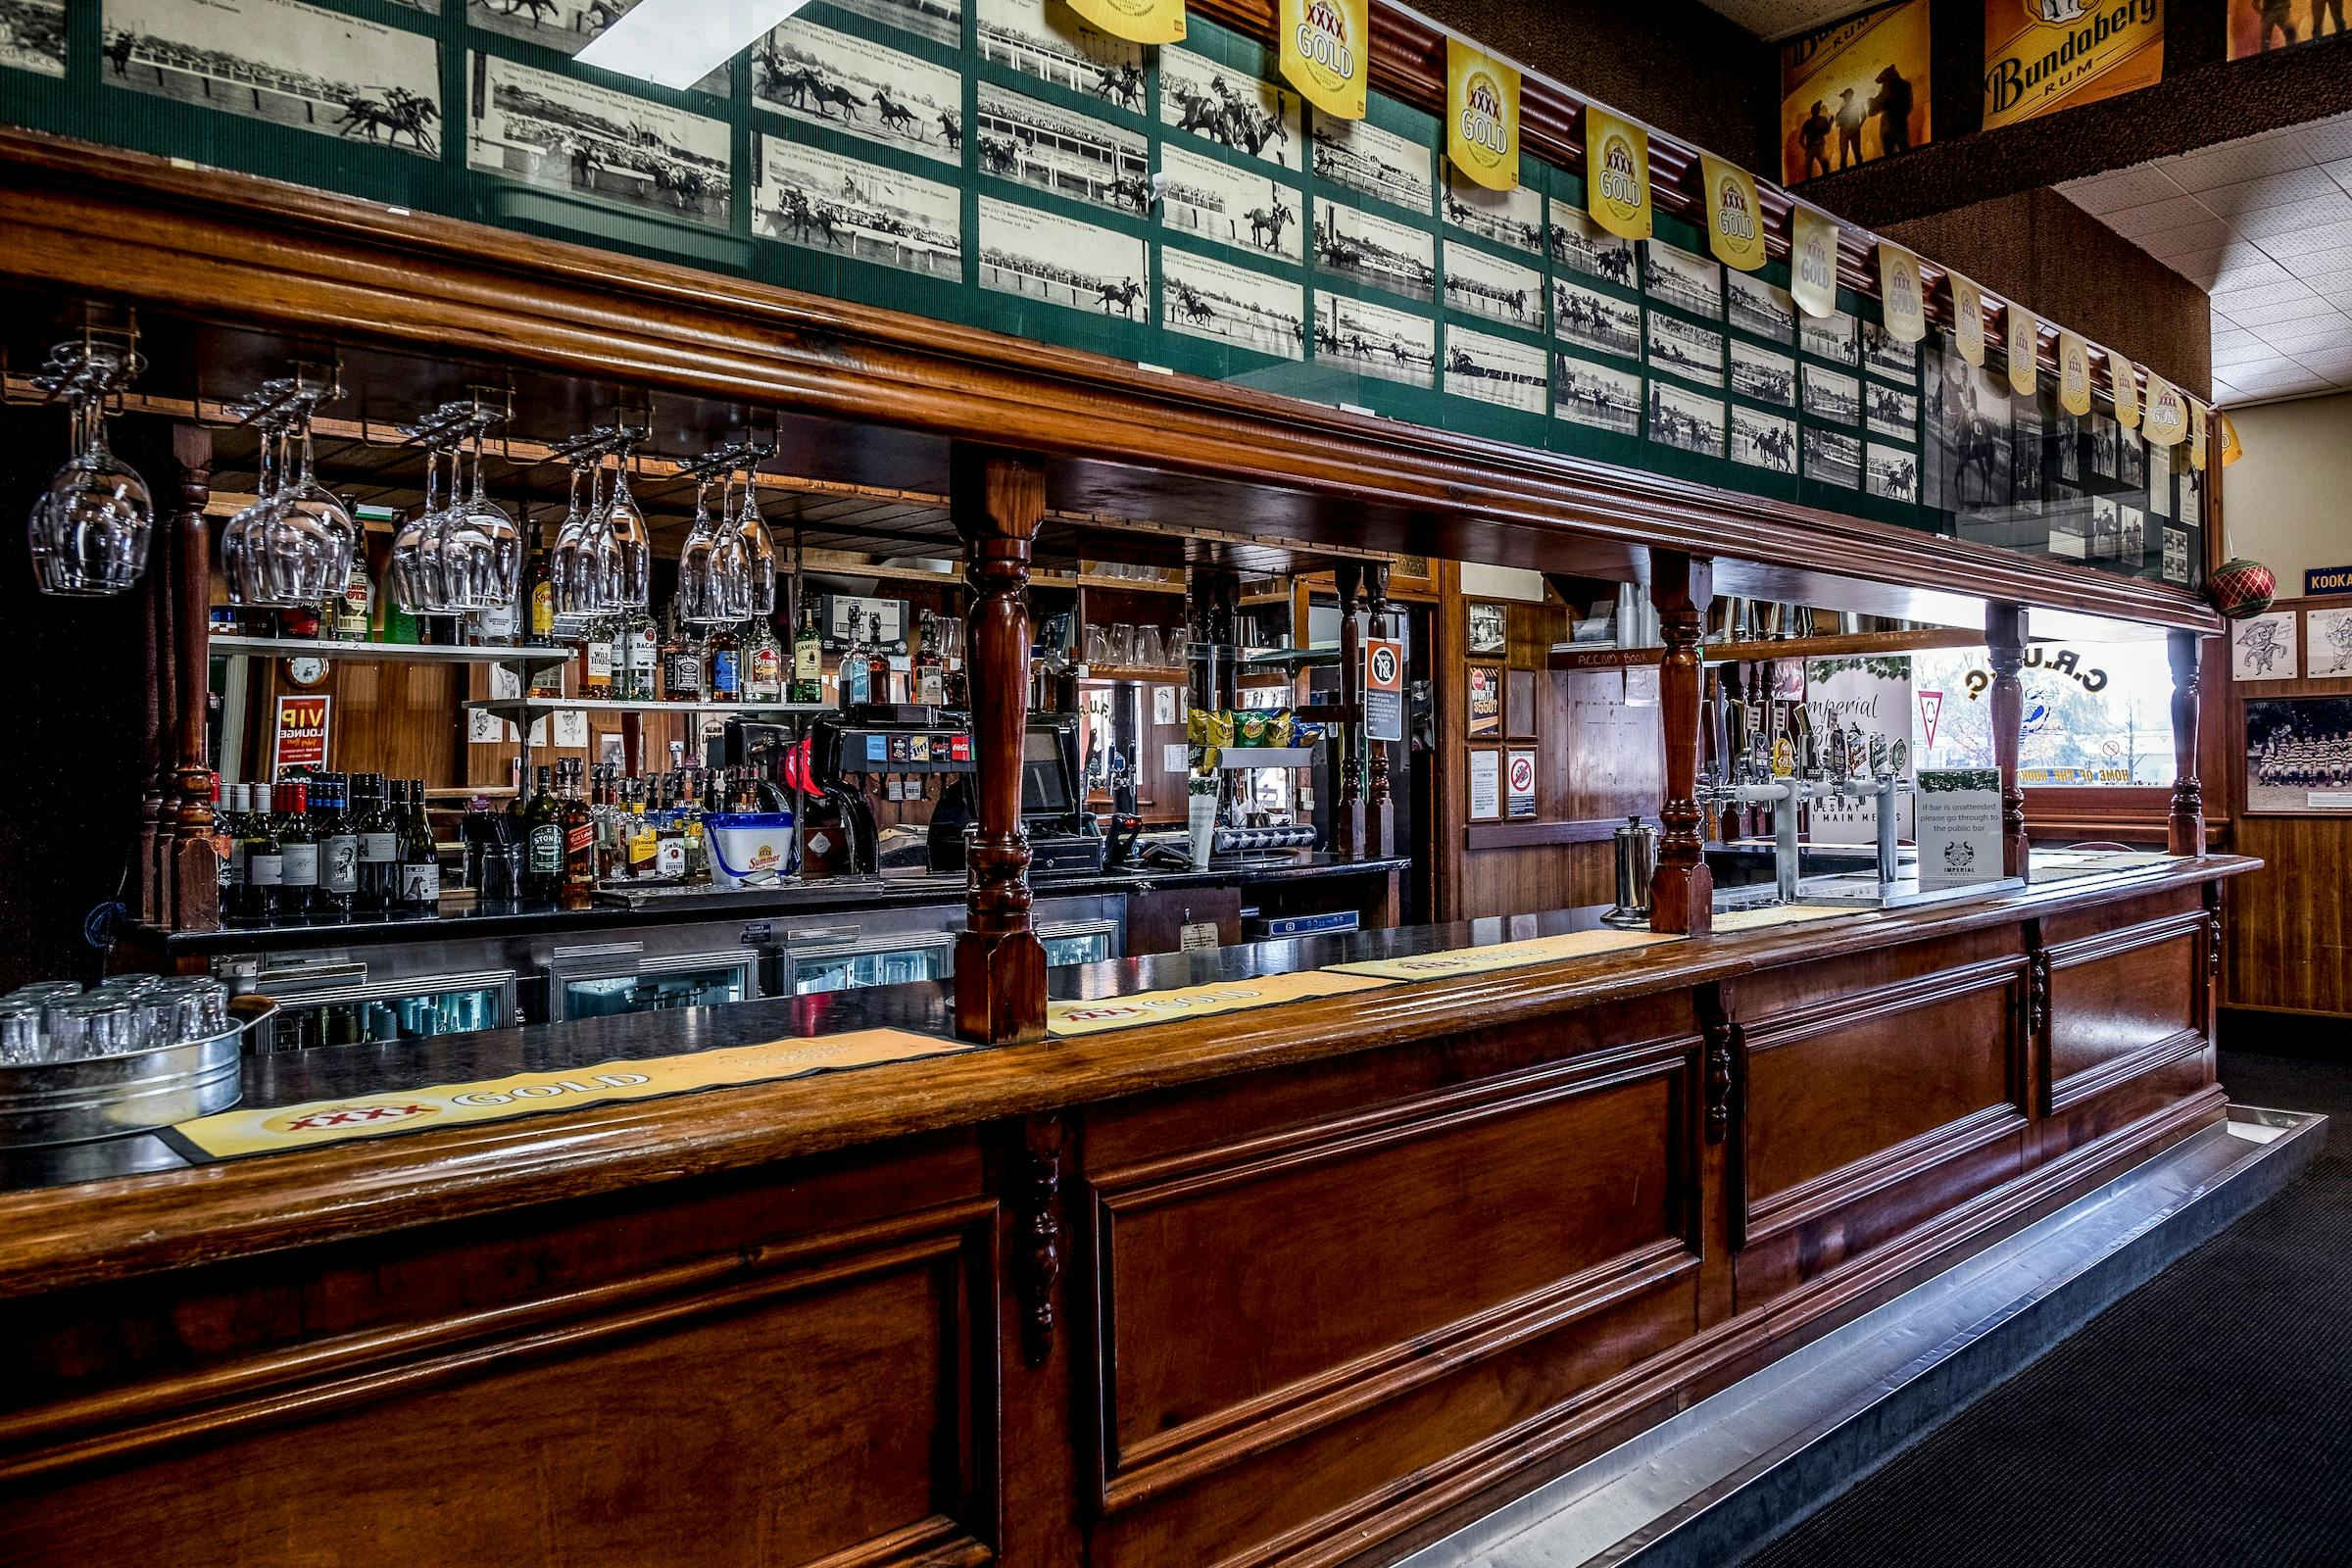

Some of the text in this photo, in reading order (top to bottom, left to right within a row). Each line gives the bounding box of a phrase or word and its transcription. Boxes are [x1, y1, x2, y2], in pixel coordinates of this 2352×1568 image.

[1306, 4, 1345, 41] XXXX
[1832, 15, 1871, 48] RUM
[1297, 23, 1353, 78] GOLD
[1984, 0, 2156, 114] Bundaberg
[2043, 61, 2093, 97] RUM
[1469, 90, 1501, 121] XXXX
[1460, 109, 1508, 155] GOLD
[1606, 152, 1635, 177] XXXX
[1598, 170, 1642, 208] GOLD
[1722, 192, 1747, 212] XXXX
[1718, 209, 1755, 240] GOLD
[1807, 242, 1826, 261] XXXX
[1800, 259, 1830, 290] GOLD
[1893, 275, 1911, 291] XXXX
[1889, 291, 1917, 316] GOLD
[2158, 396, 2177, 408] XXXX
[2152, 408, 2180, 425] GOLD
[2312, 573, 2352, 589] KOOKA
[1578, 653, 1648, 665] ACCOM BOOK
[1471, 689, 1494, 701] WORTH
[1485, 681, 1496, 691] IS IT
[1473, 700, 1497, 714] $550?
[1807, 694, 1880, 723] mperial
[1813, 804, 1860, 812] UESDAY
[1823, 813, 1901, 822] MAIN MES
[1958, 813, 1988, 823] through
[1947, 824, 1972, 833] public
[749, 854, 781, 869] Summer
[1143, 989, 1261, 1008] GOLD
[288, 1073, 651, 1131] XXXX GOLD
